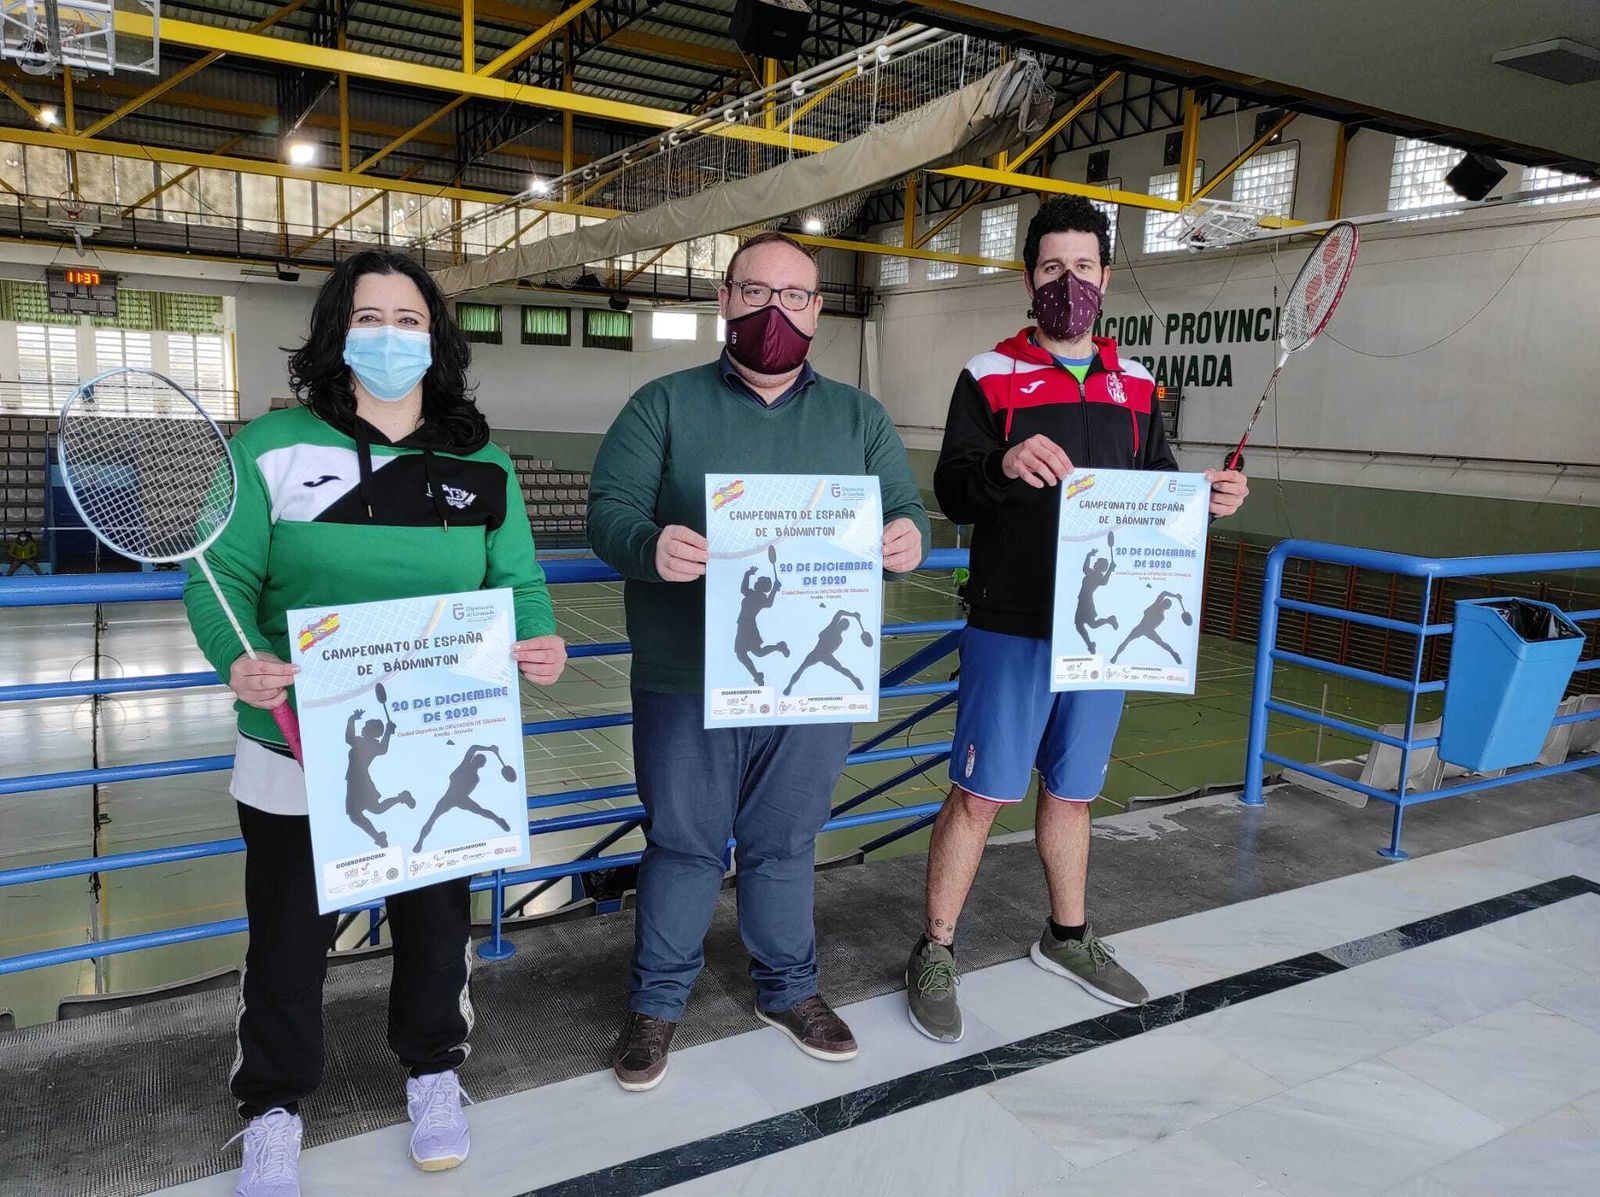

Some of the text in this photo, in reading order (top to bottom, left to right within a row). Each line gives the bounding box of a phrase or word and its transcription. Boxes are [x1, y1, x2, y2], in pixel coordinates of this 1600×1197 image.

[68, 271, 99, 285] 11:37
[1079, 500, 1185, 512] CAMPEONATO DE ESPAÑA
[729, 508, 856, 521] CAMPEONATO DE ESPAÑA
[1098, 514, 1165, 526] DE BÁDMINTON
[755, 524, 835, 537] DE BÁDMINTON
[1116, 547, 1197, 557] 20 DE DICIEMBRE
[780, 561, 873, 572] 20 DE DICIEMBRE
[1134, 559, 1172, 568] DE 2020
[803, 575, 847, 585] DE 2020
[322, 631, 483, 661] CAMPEONATO DE ESPAÑA
[357, 653, 459, 676] DE BÁDMINTON
[392, 686, 508, 712] 20 DE DICIEMBRE
[423, 706, 478, 723] DE 2020
